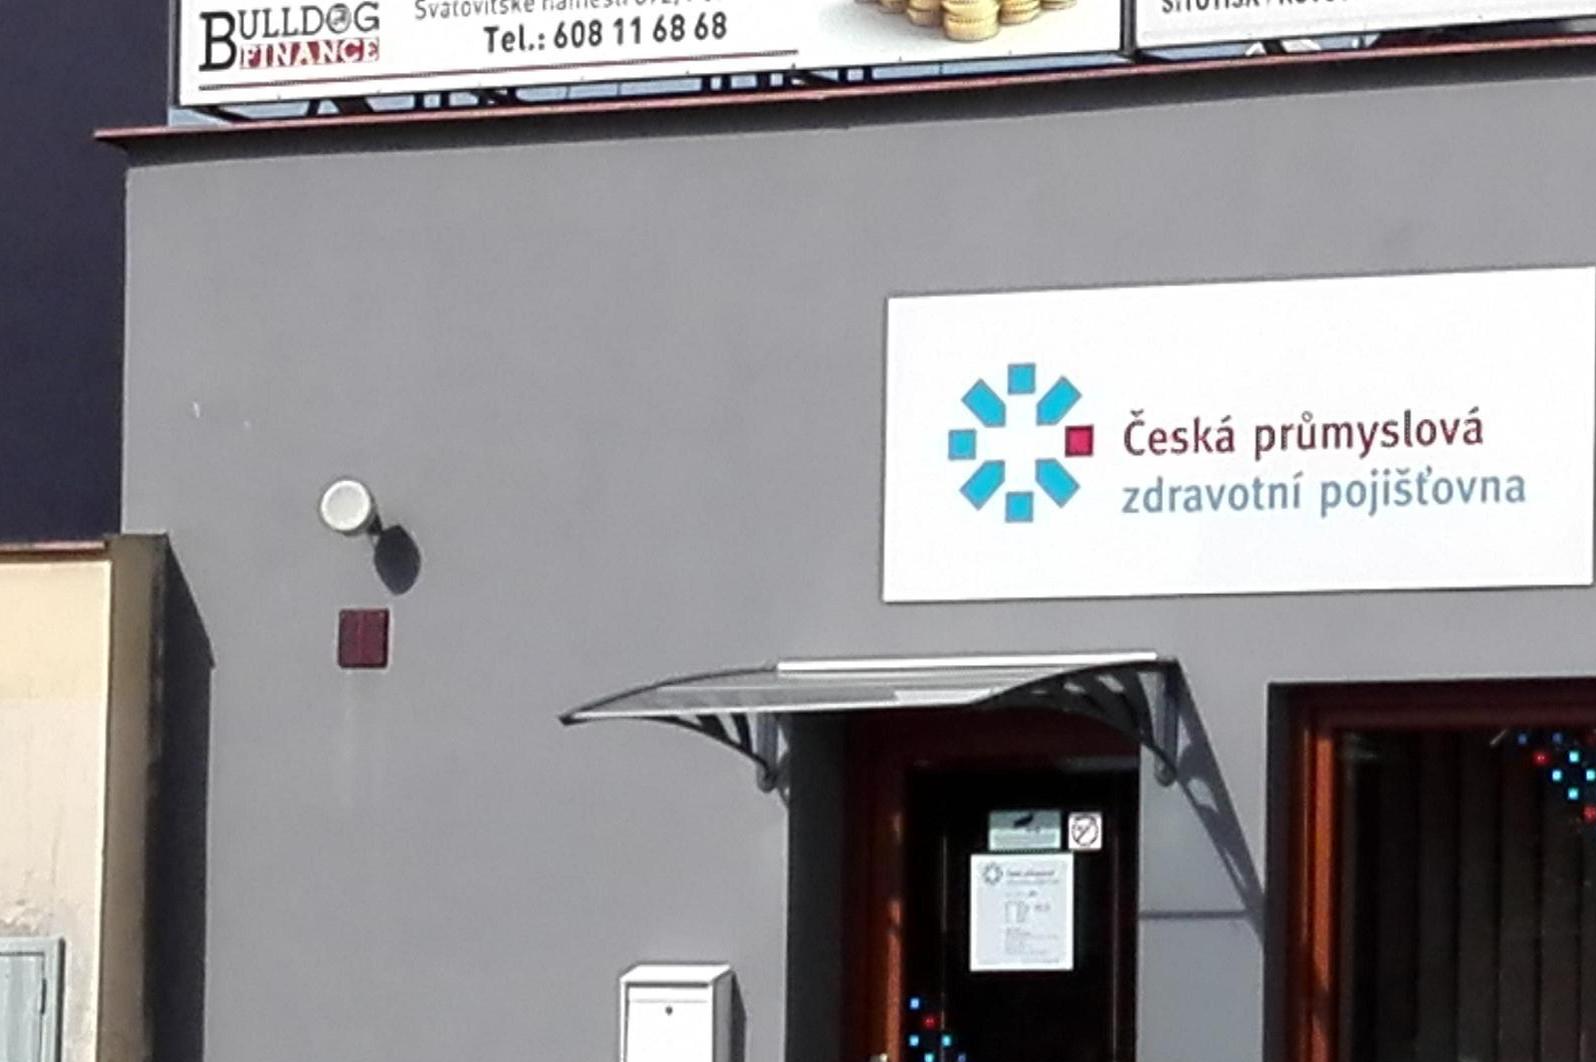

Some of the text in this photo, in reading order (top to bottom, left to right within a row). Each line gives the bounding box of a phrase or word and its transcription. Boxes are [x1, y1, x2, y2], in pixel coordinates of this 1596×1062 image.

[199, 1, 380, 71] BULLDOG
[240, 37, 380, 69] FINANCE
[484, 11, 727, 53] Tel.: 608 11 68 68
[1123, 405, 1484, 461] Česká průmyslová
[1122, 464, 1526, 517] zdravotní pojišťovna
